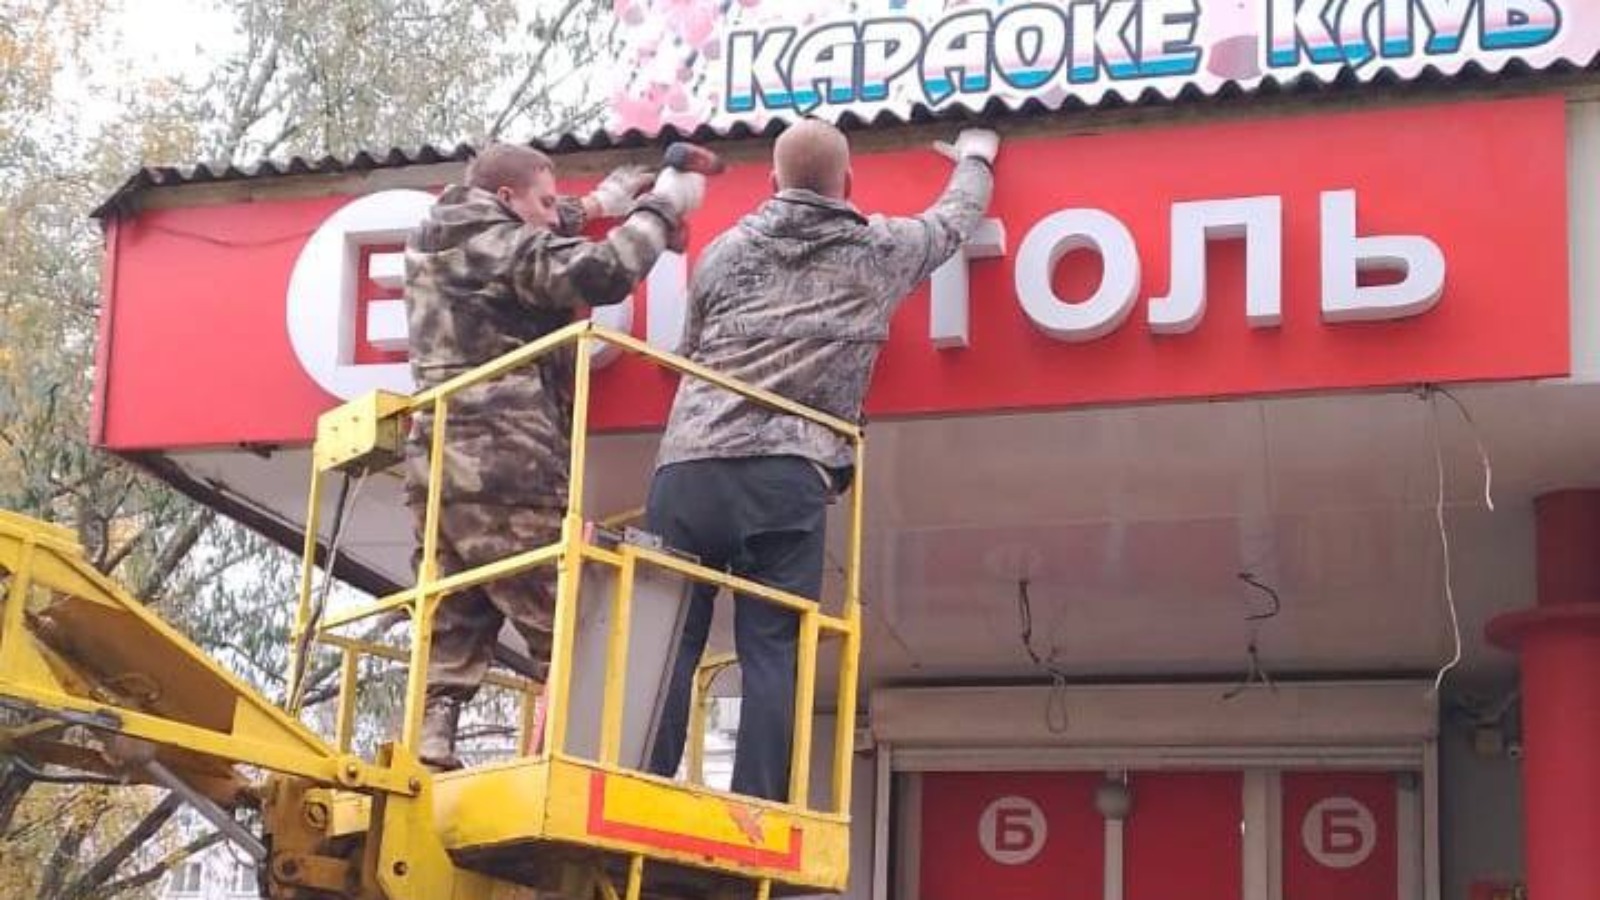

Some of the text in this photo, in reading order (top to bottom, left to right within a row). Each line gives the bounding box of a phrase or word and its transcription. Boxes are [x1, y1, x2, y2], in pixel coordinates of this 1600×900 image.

[725, 0, 1202, 116] КАРАОКЕ
[995, 808, 1034, 851] Б
[1322, 810, 1363, 854] Б
